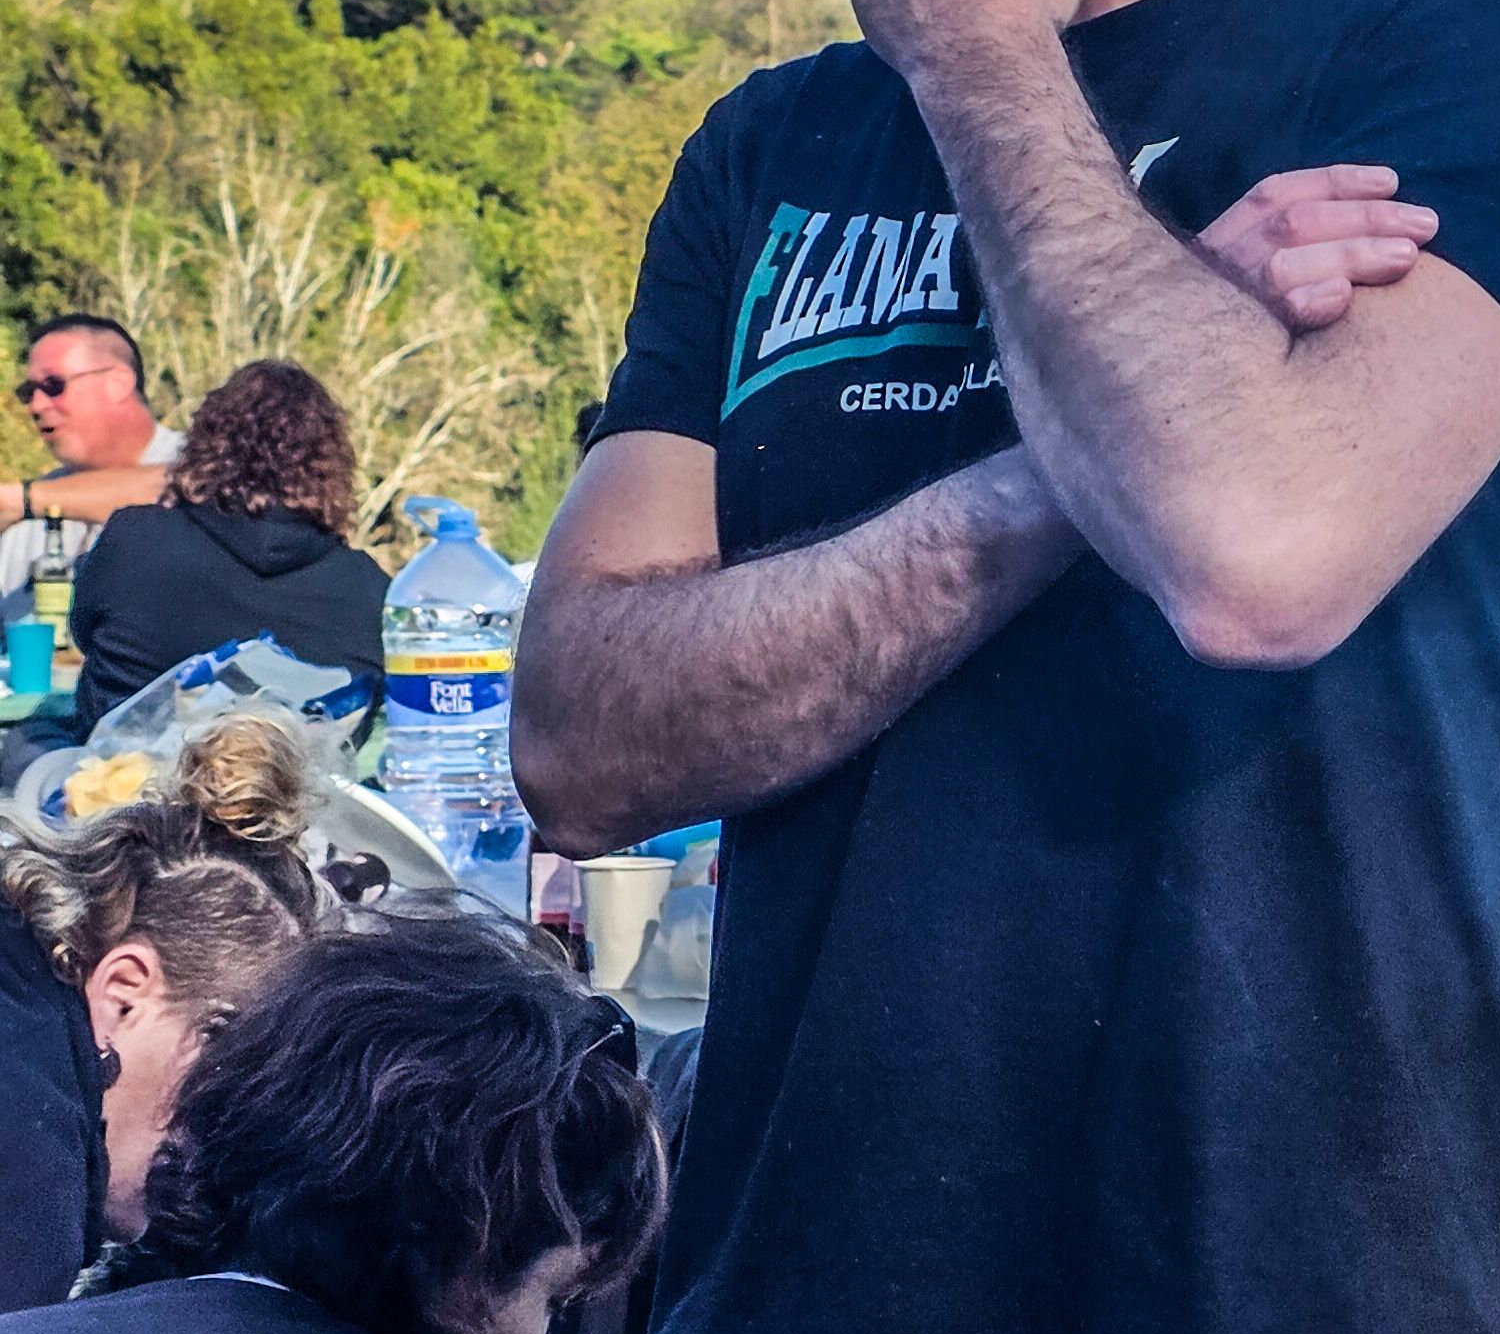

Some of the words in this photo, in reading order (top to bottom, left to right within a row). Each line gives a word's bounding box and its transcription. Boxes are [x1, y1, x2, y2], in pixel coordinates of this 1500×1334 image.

[721, 202, 966, 397] FLANA
[429, 681, 473, 698] Font
[429, 696, 475, 714] Vella
